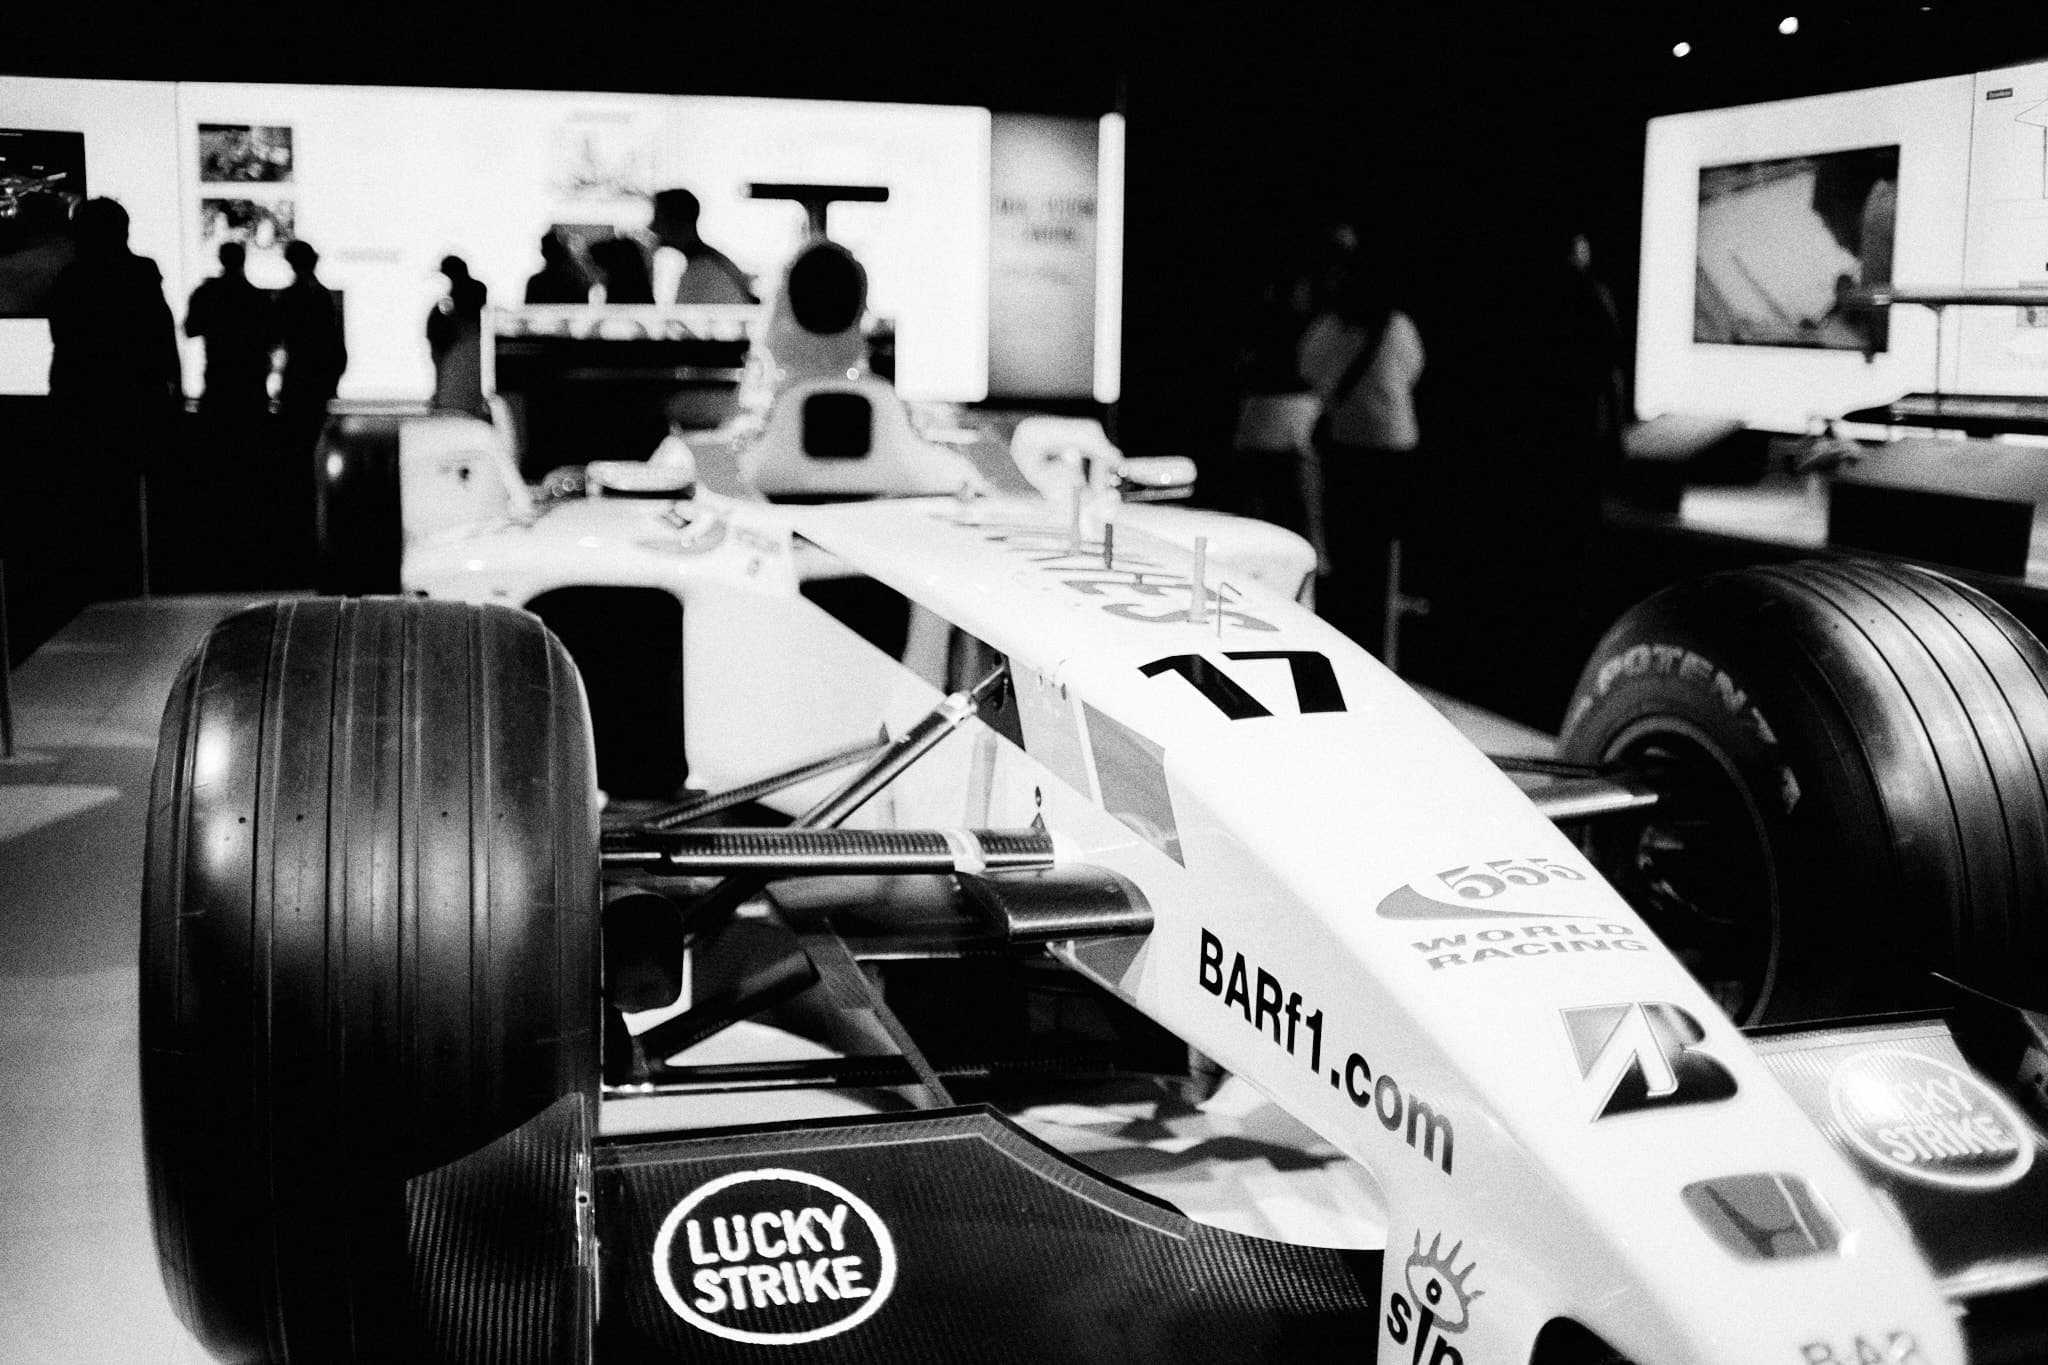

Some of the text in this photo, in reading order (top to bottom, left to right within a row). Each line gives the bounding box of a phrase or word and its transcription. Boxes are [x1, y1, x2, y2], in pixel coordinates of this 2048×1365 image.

[1138, 650, 1347, 720] 17
[1436, 858, 1586, 899] 555
[1411, 924, 1633, 952] WORLD
[1426, 939, 1649, 970] RACING
[1199, 927, 1455, 1176] BARf1.com
[1877, 1113, 2018, 1163] STRIKE
[686, 1203, 848, 1265] LUCKY
[693, 1256, 871, 1314] STRIKE
